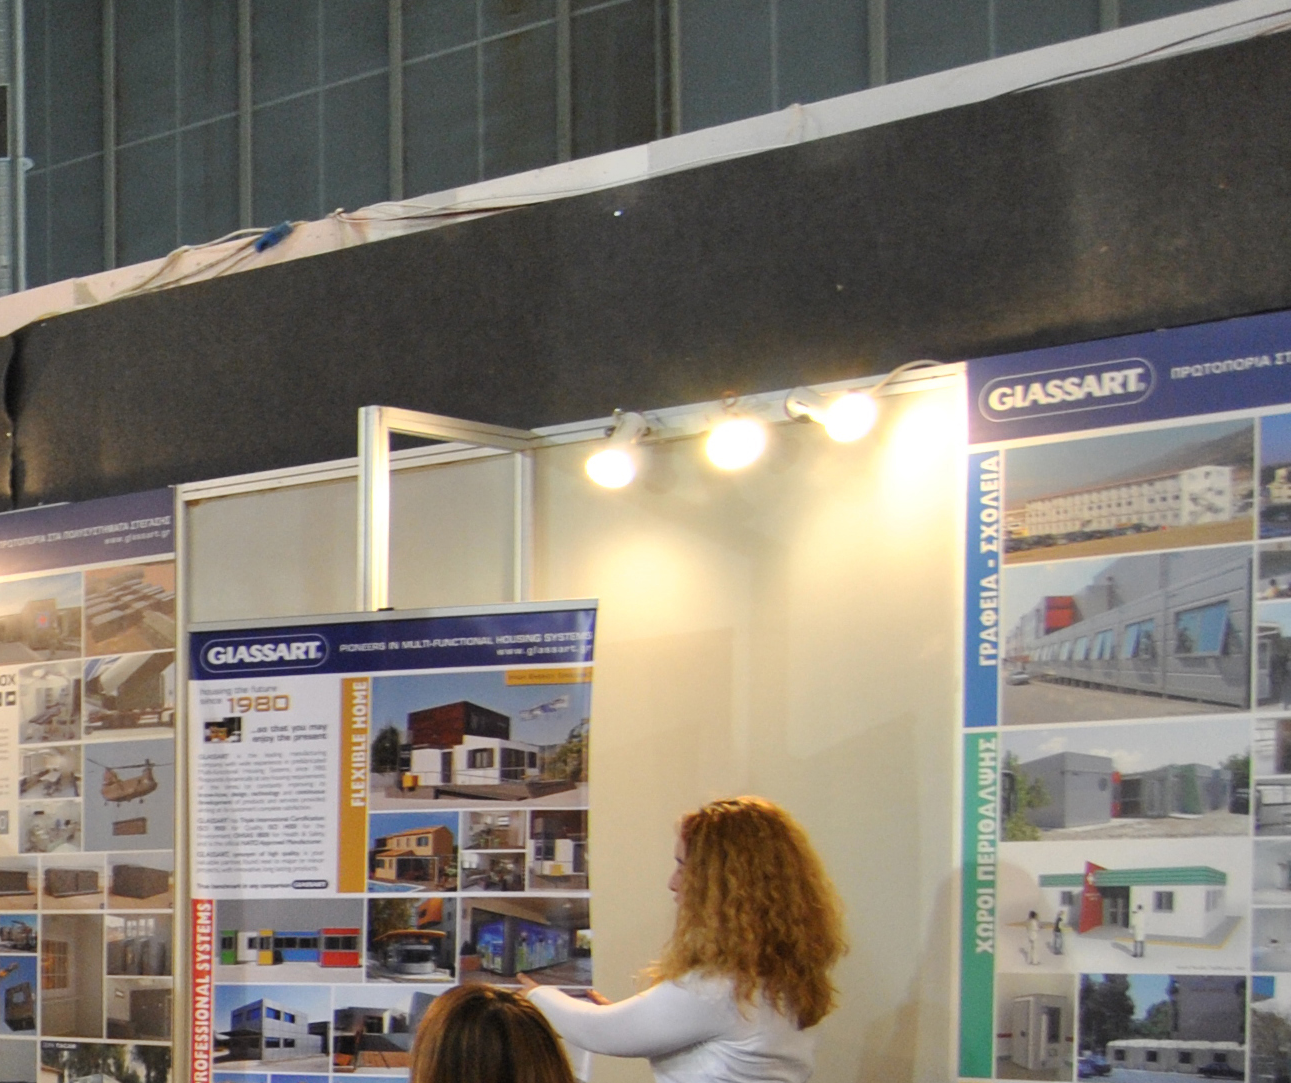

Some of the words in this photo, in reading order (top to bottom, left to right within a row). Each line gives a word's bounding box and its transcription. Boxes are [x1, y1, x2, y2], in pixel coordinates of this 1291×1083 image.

[227, 695, 290, 713] 1980
[352, 681, 368, 729] HOME
[350, 733, 367, 807] FLEXIBLE
[195, 902, 212, 971] SYSTEMS
